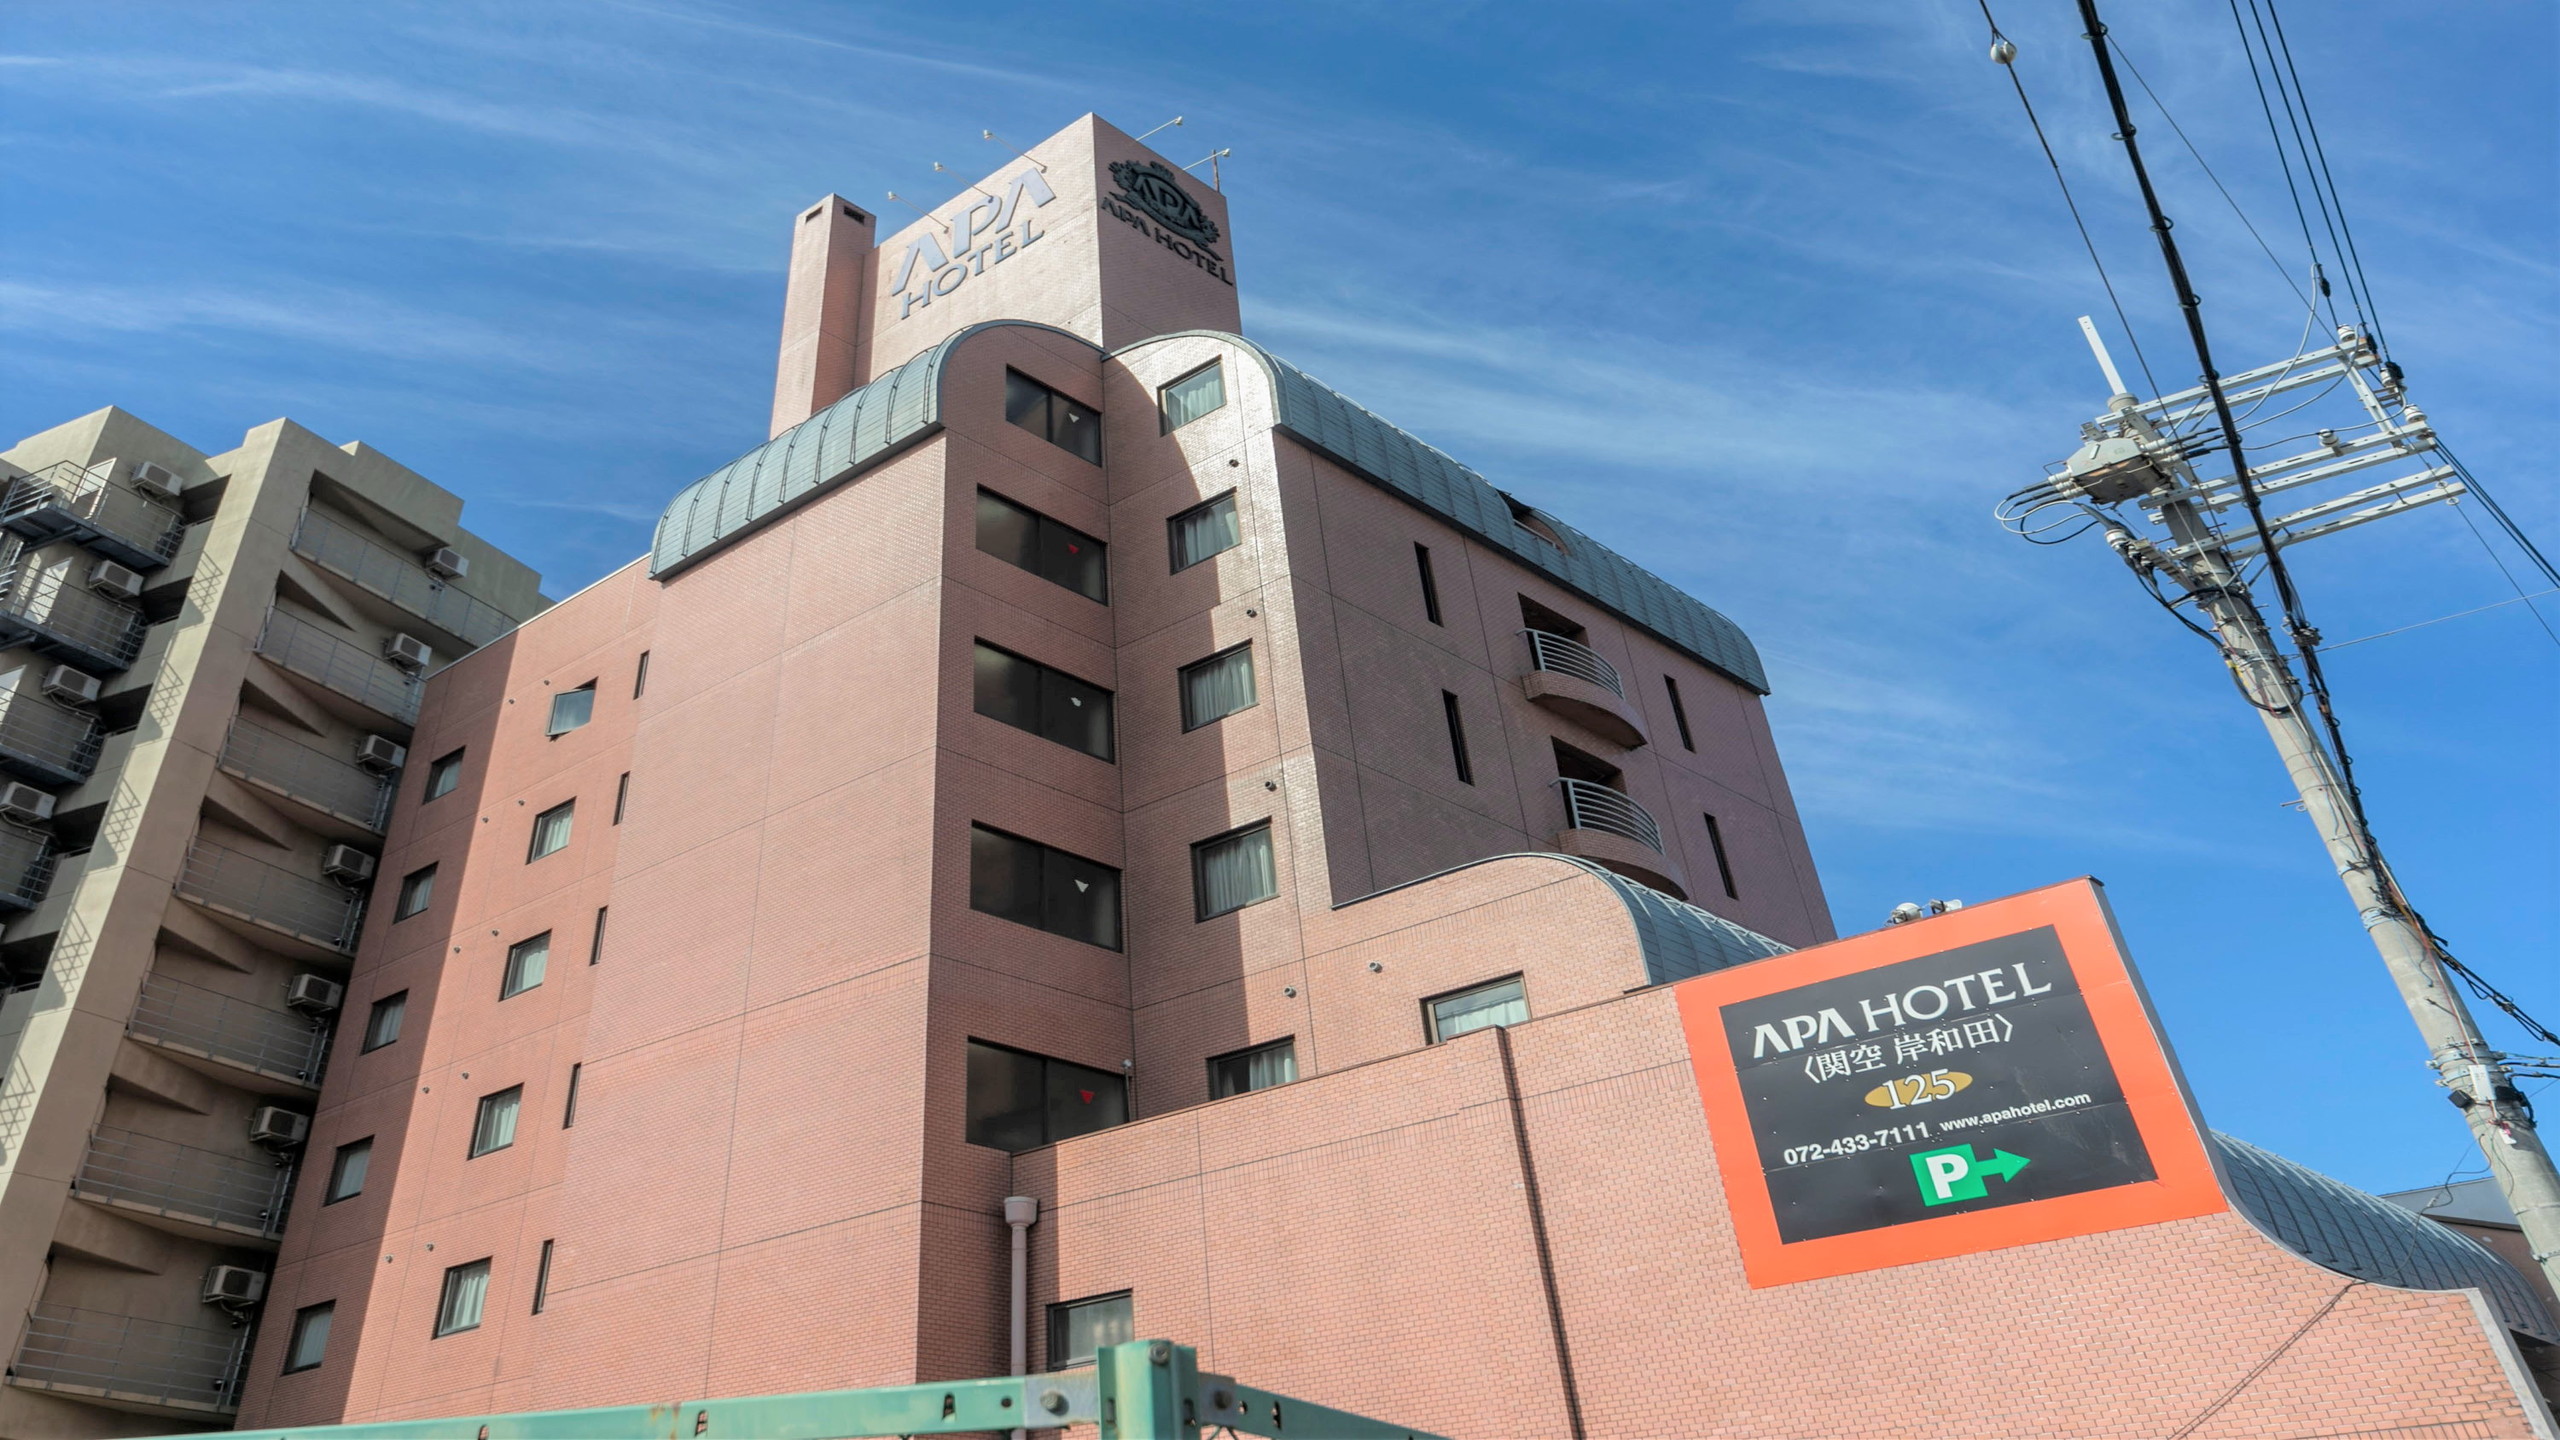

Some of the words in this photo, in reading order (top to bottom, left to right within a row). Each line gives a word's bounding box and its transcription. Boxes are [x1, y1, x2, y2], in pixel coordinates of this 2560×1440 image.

[891, 167, 1056, 296] APA
[902, 220, 1045, 319] HOTEL
[1101, 197, 1150, 236] APA
[1155, 229, 1234, 286] HOTEL
[1754, 1008, 1854, 1058] APA
[1860, 962, 2052, 1032] HOTEL
[1784, 1122, 1929, 1165] 072-433-7111
[1940, 1092, 2091, 1132] www.apahotel.com
[1882, 1069, 1957, 1110] 125
[1925, 1153, 1969, 1199] P
